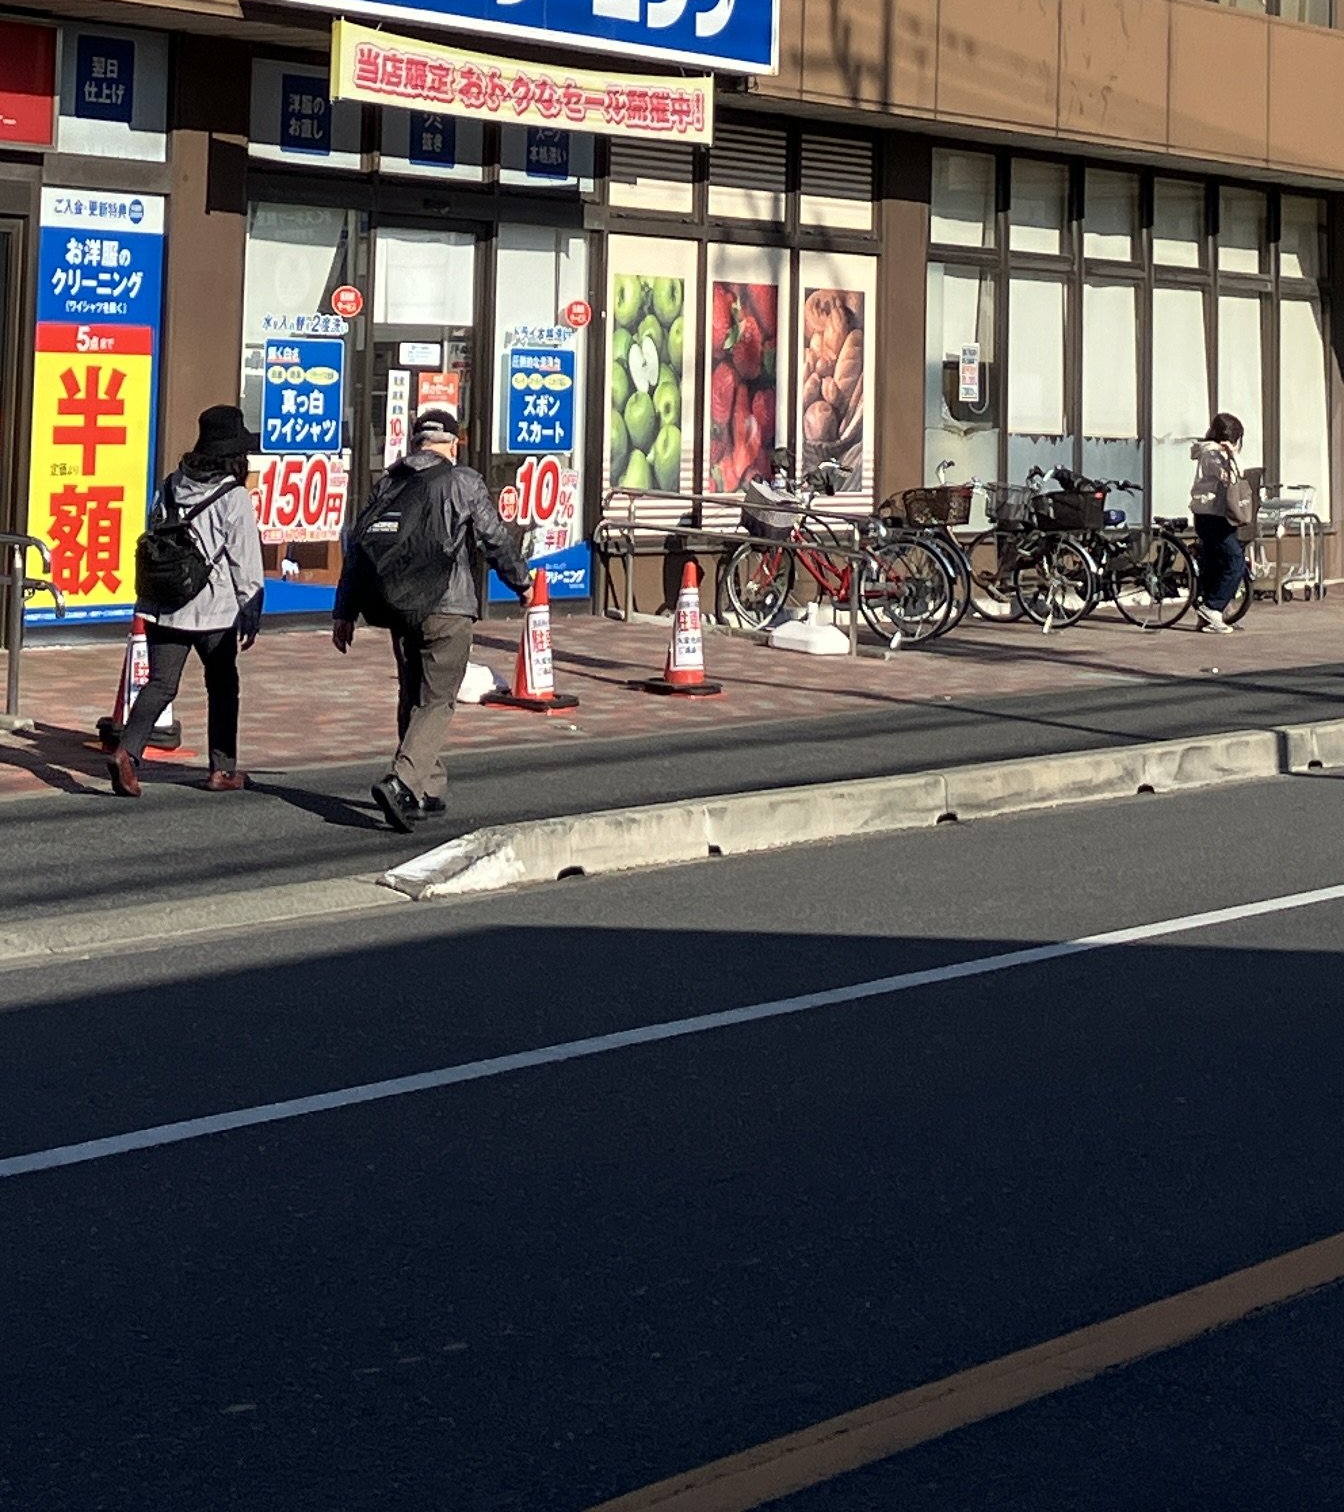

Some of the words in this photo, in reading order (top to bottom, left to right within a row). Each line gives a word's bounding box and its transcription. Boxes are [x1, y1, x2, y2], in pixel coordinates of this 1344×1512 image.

[92, 56, 119, 79] 翌日
[84, 80, 126, 105] 仕上げ
[288, 93, 326, 116] 洋服の
[288, 118, 324, 139] お直し
[65, 237, 132, 268] お洋服の
[51, 268, 144, 299] クリーニング
[76, 324, 116, 353] 5点まで
[281, 388, 325, 416] 真っ白
[523, 394, 560, 418] ズボン
[266, 417, 337, 444] ワイシャツ
[516, 420, 565, 445] スカート
[47, 365, 129, 596] 半額
